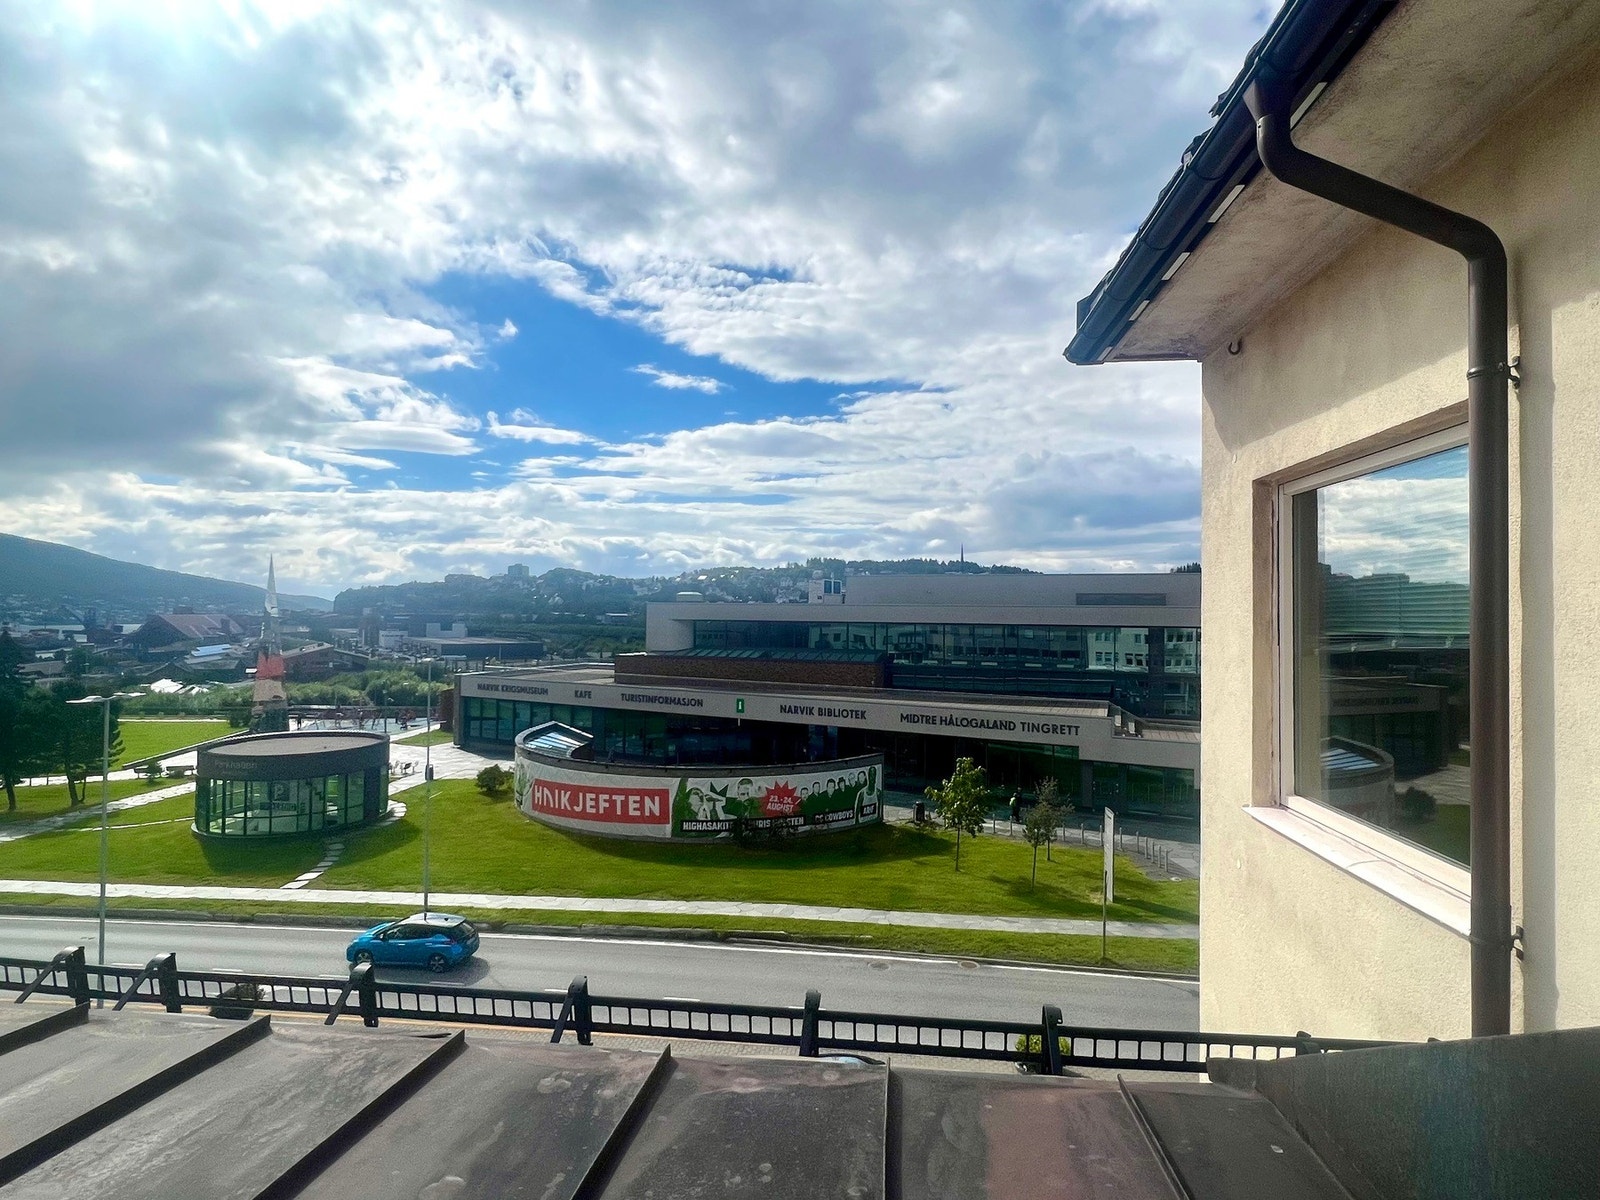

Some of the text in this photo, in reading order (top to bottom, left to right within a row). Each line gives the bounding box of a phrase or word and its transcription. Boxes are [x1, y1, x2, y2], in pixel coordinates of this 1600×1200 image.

[477, 683, 549, 696] NARVIK KRIGSMUSEUM
[574, 689, 592, 699] KAFE
[621, 693, 704, 707] TURISTINFORMASJON
[779, 704, 867, 720] NARVIK BIBLIOTEK
[900, 712, 1081, 736] MIDTRE HÅLOGALAND TINGRETT
[766, 803, 794, 812] AUGUST
